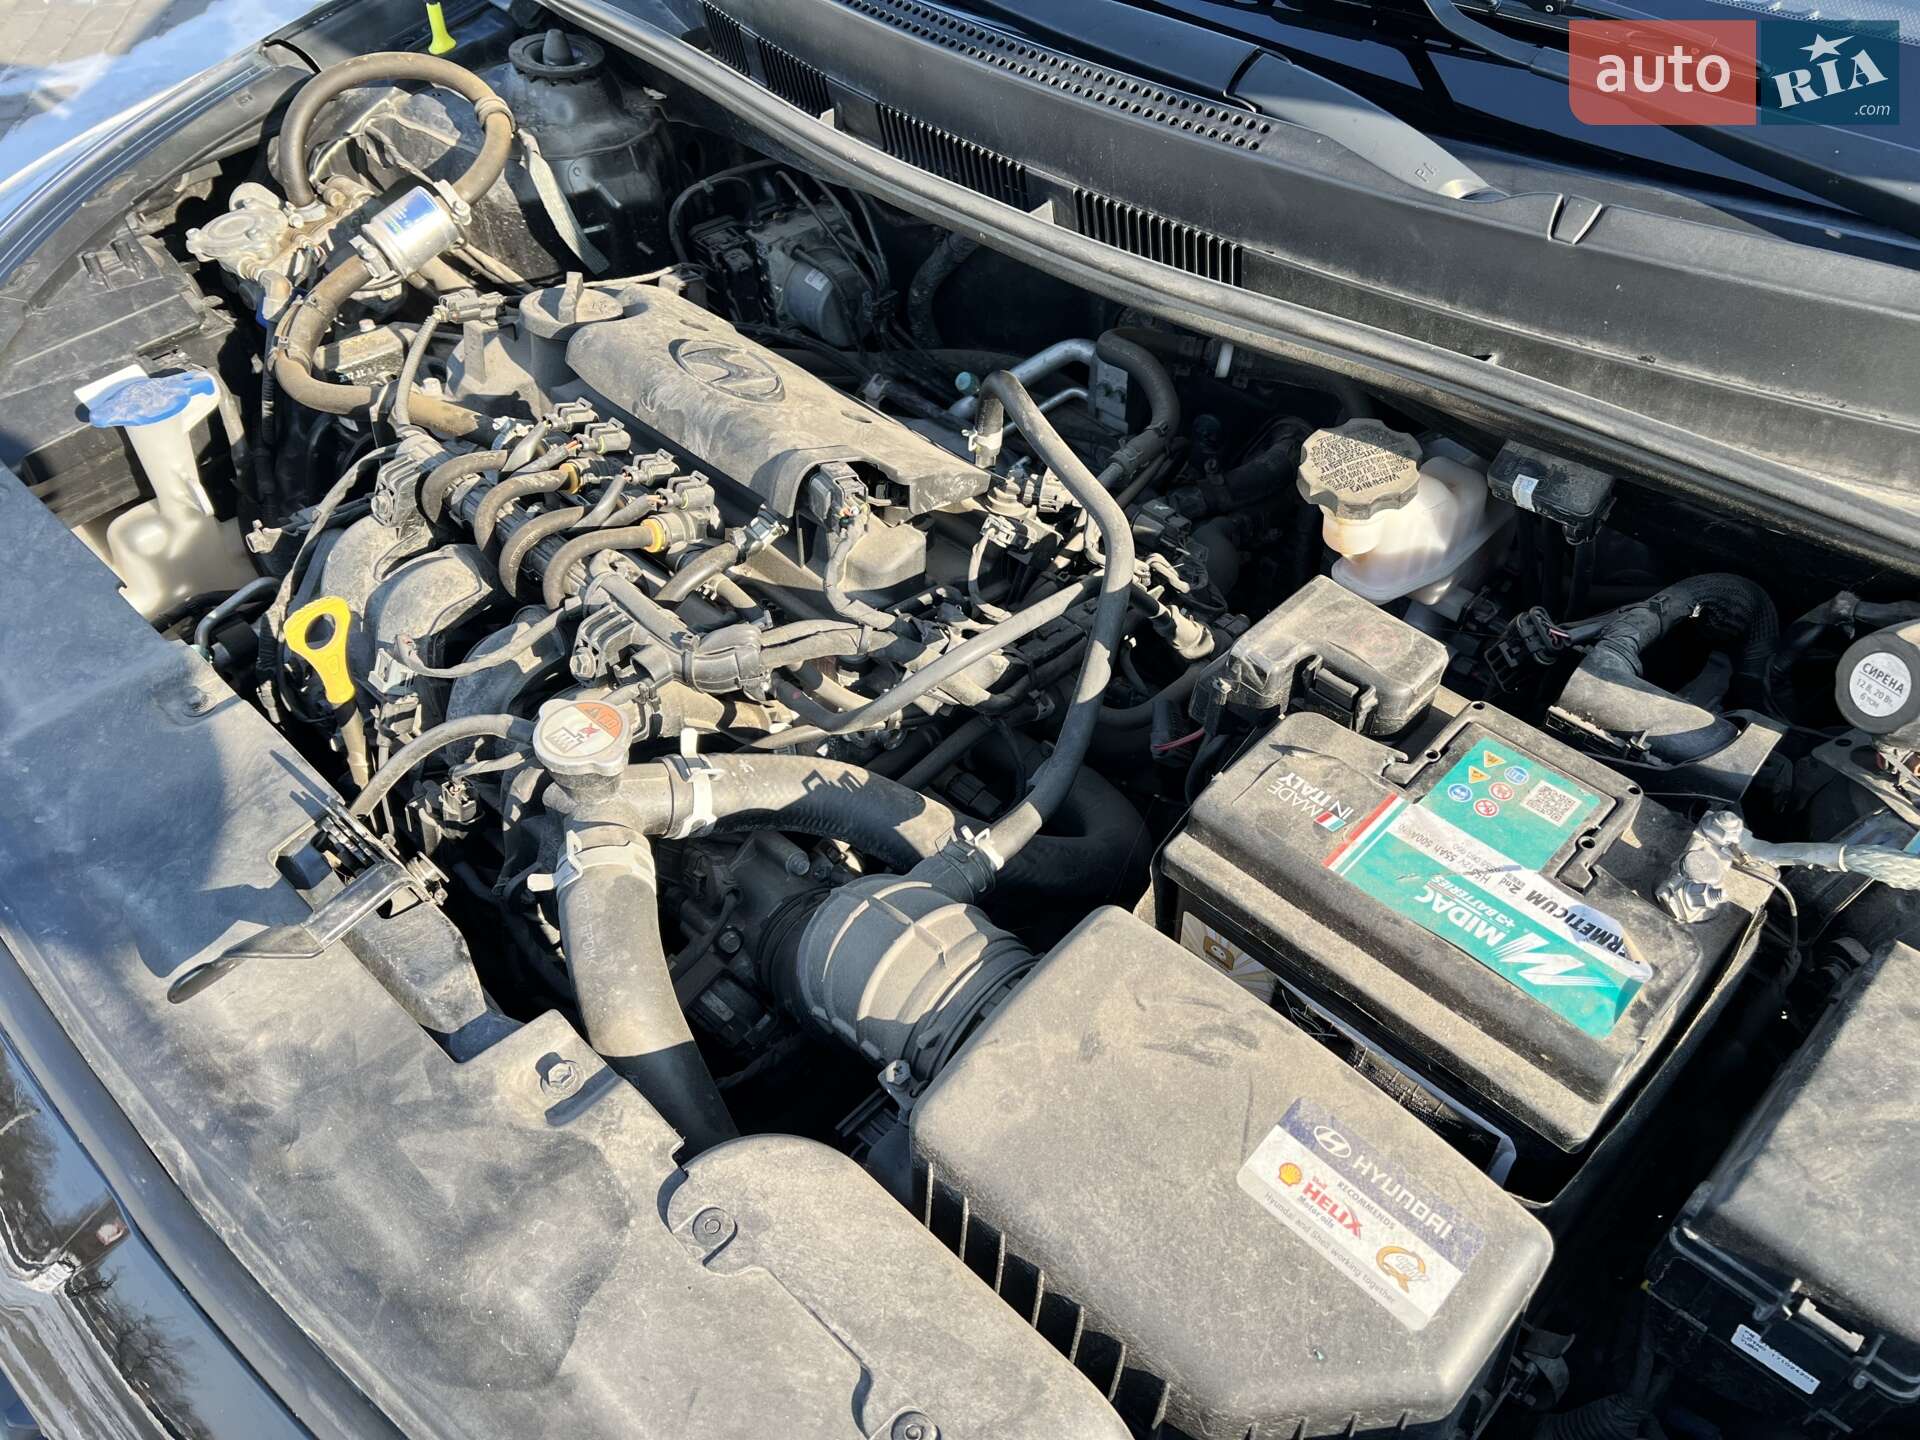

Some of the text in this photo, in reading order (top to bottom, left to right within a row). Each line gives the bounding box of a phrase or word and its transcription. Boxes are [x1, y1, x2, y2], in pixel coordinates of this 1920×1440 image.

[1856, 678, 1866, 689] 12
[1862, 662, 1904, 695] СИРЕНА
[1267, 780, 1324, 817] MADE
[1278, 772, 1355, 820] IN ITALY
[1414, 884, 1508, 947] MIDAC
[1430, 874, 1499, 917] BATTERIES
[1302, 1182, 1362, 1238] HELIX
[1337, 1181, 1397, 1230] RECOMMENDS
[1353, 1155, 1453, 1239] HYUNDAI
[1330, 1247, 1362, 1278] working
